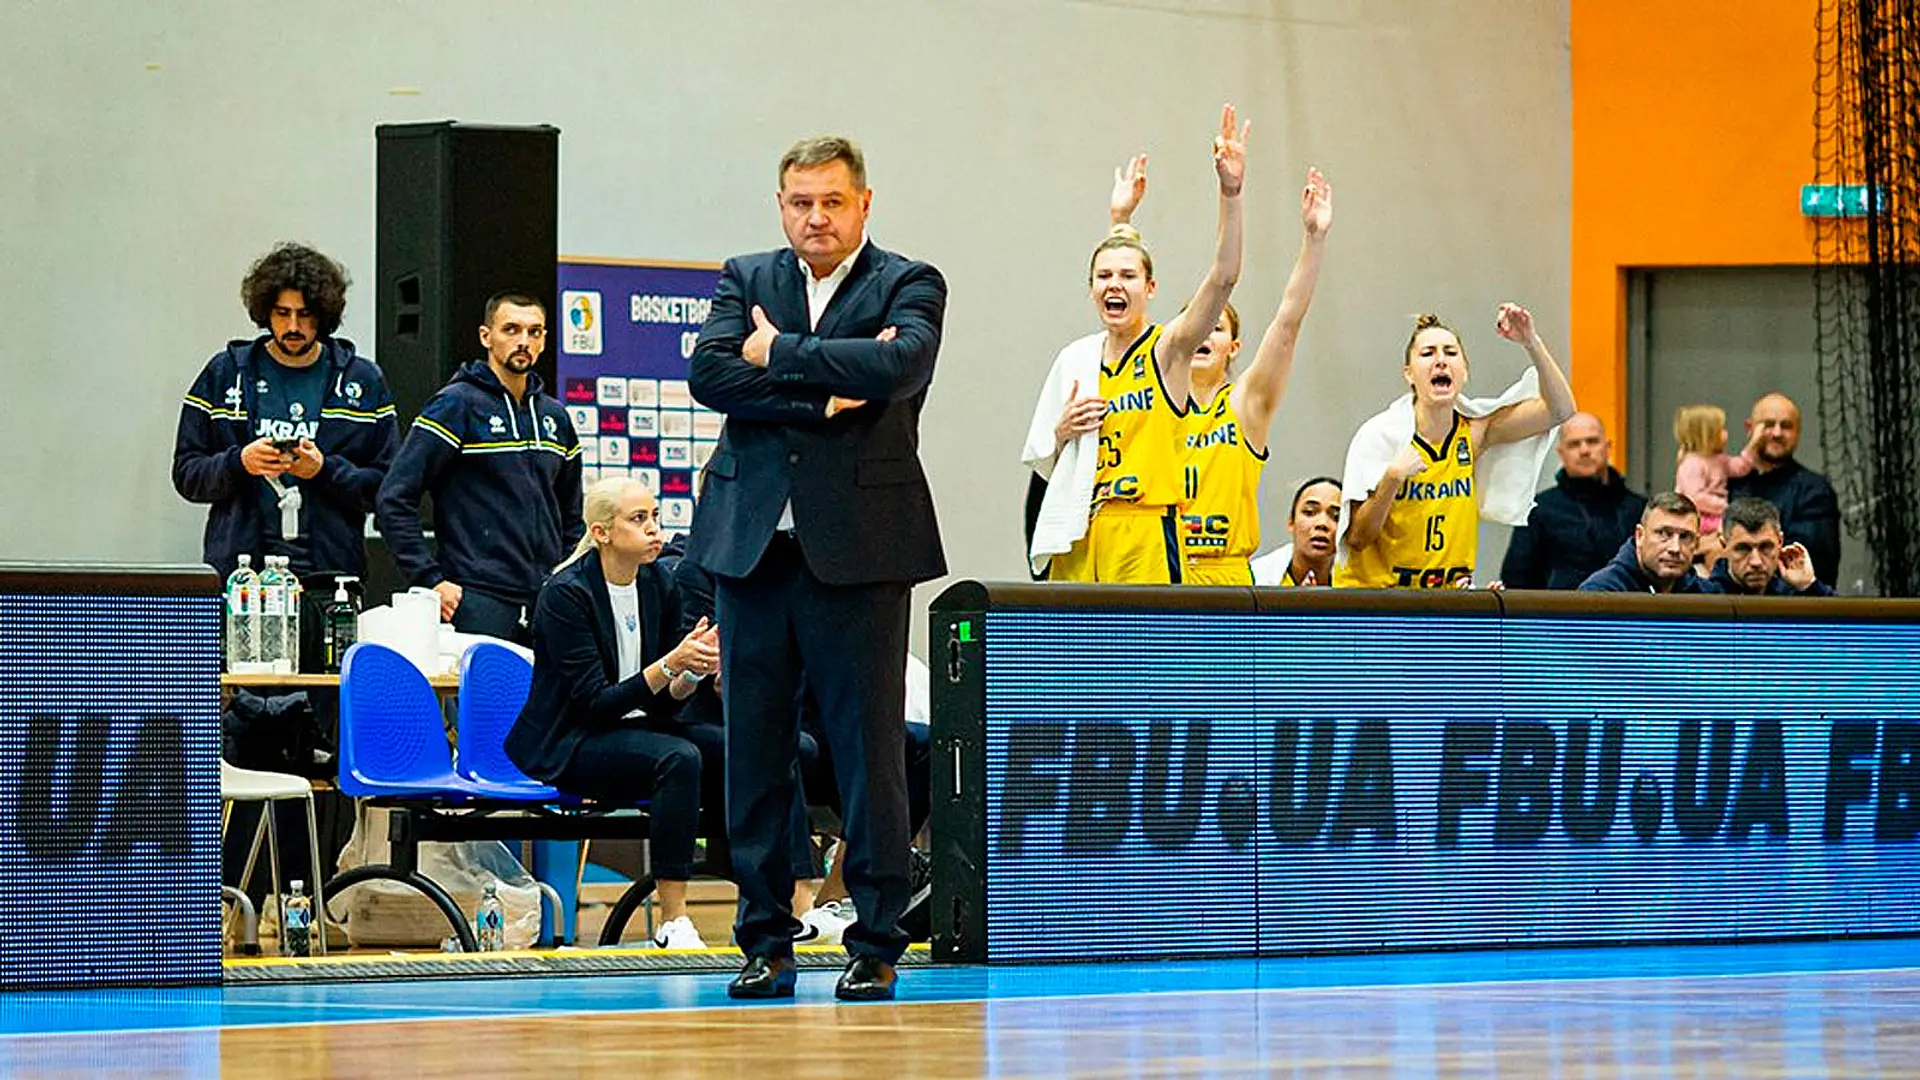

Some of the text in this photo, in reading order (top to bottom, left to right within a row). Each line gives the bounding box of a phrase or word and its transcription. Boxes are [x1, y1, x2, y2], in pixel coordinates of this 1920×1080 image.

[631, 295, 713, 324] BASKETBA
[1424, 515, 1446, 552] 15
[17, 713, 190, 859] UA
